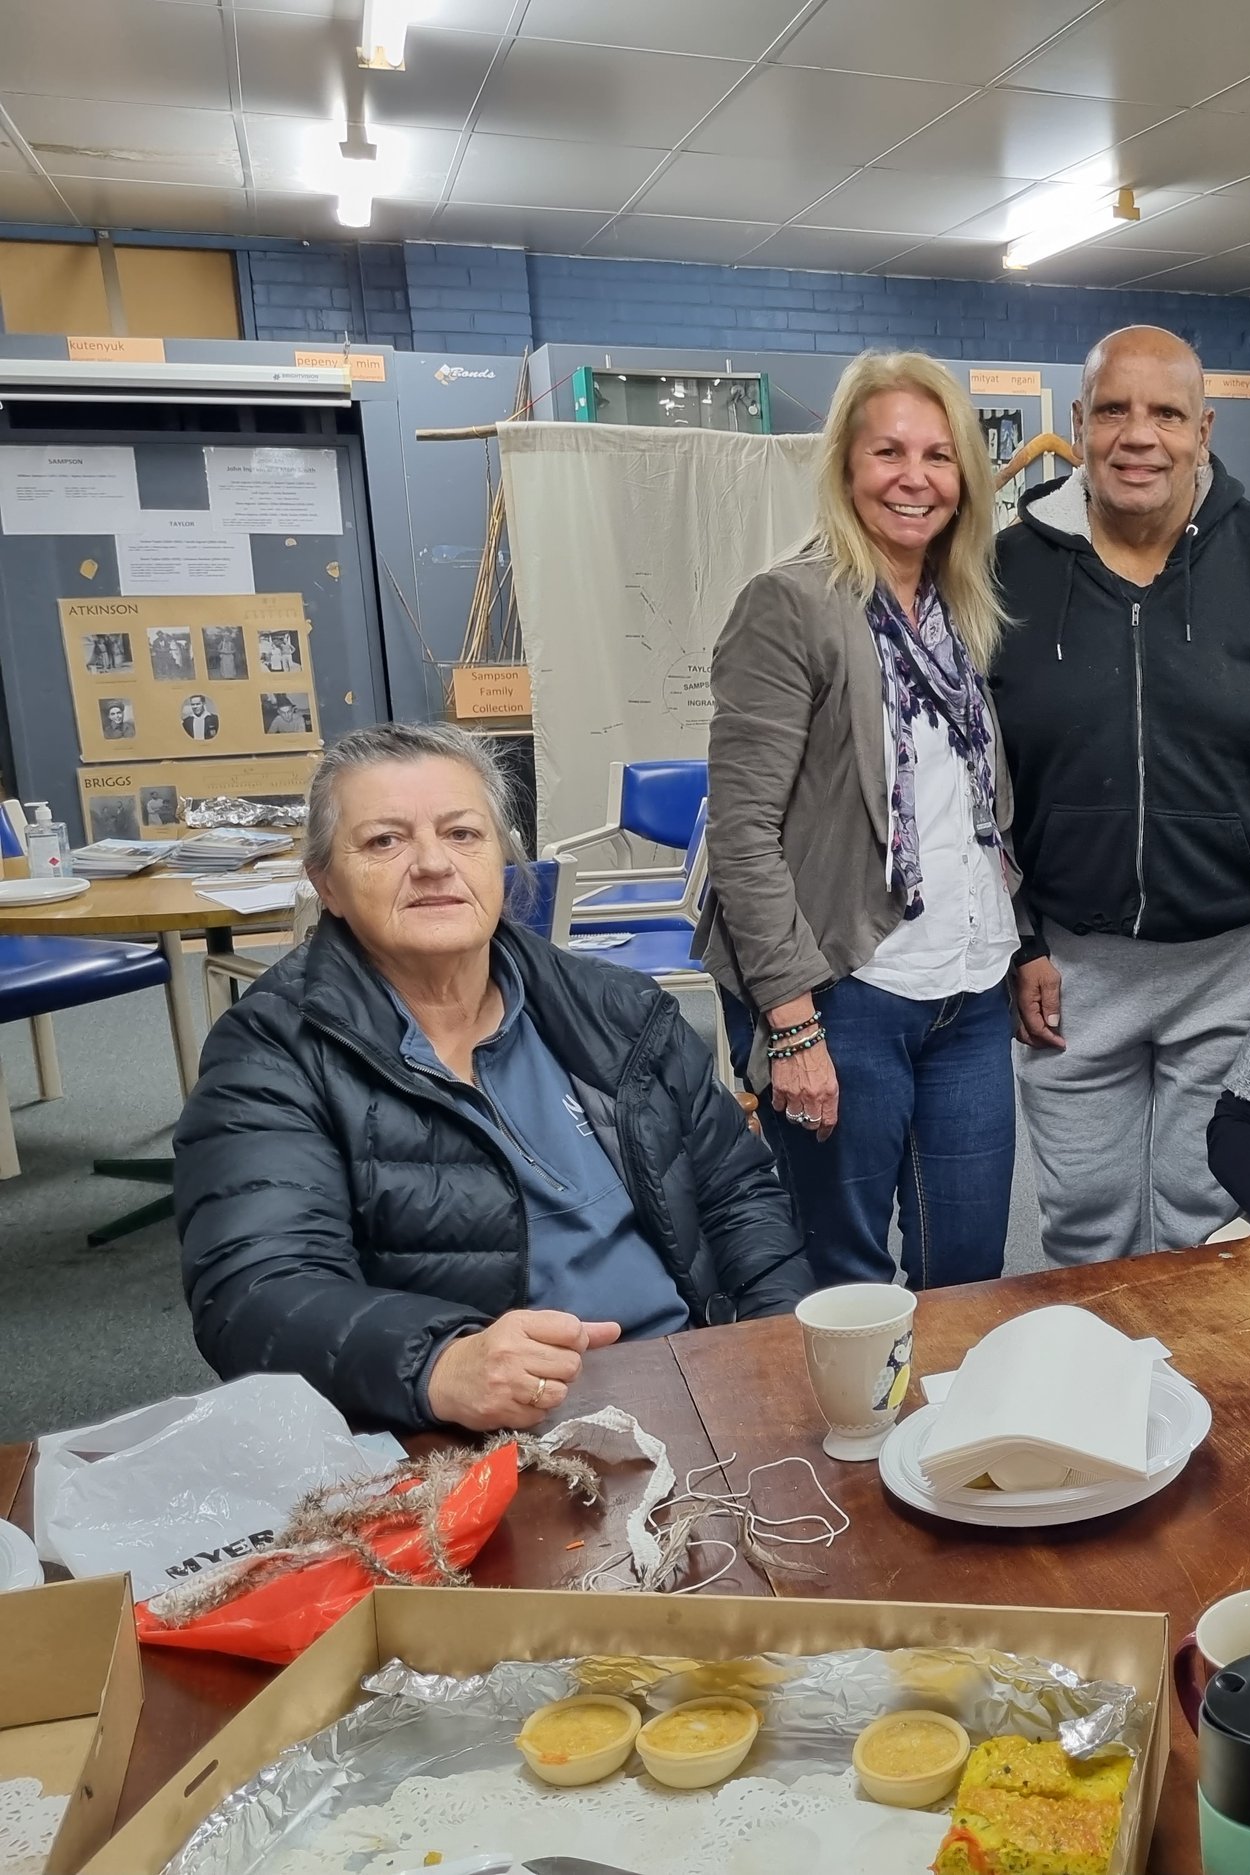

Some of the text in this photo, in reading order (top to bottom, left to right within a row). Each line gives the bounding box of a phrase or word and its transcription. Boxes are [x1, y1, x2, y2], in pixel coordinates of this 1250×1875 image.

[68, 340, 125, 352] kutenyuk
[356, 360, 380, 369] mim
[971, 374, 1035, 386] mityat ngani
[68, 604, 139, 616] ATKINSON
[687, 665, 712, 673] TAYLO
[471, 671, 519, 681] Sampson
[479, 686, 513, 697] Family
[683, 681, 710, 691] SAMPS
[472, 704, 524, 713] Collection
[84, 776, 131, 789] BRIGGS
[165, 1529, 275, 1580] MYER
